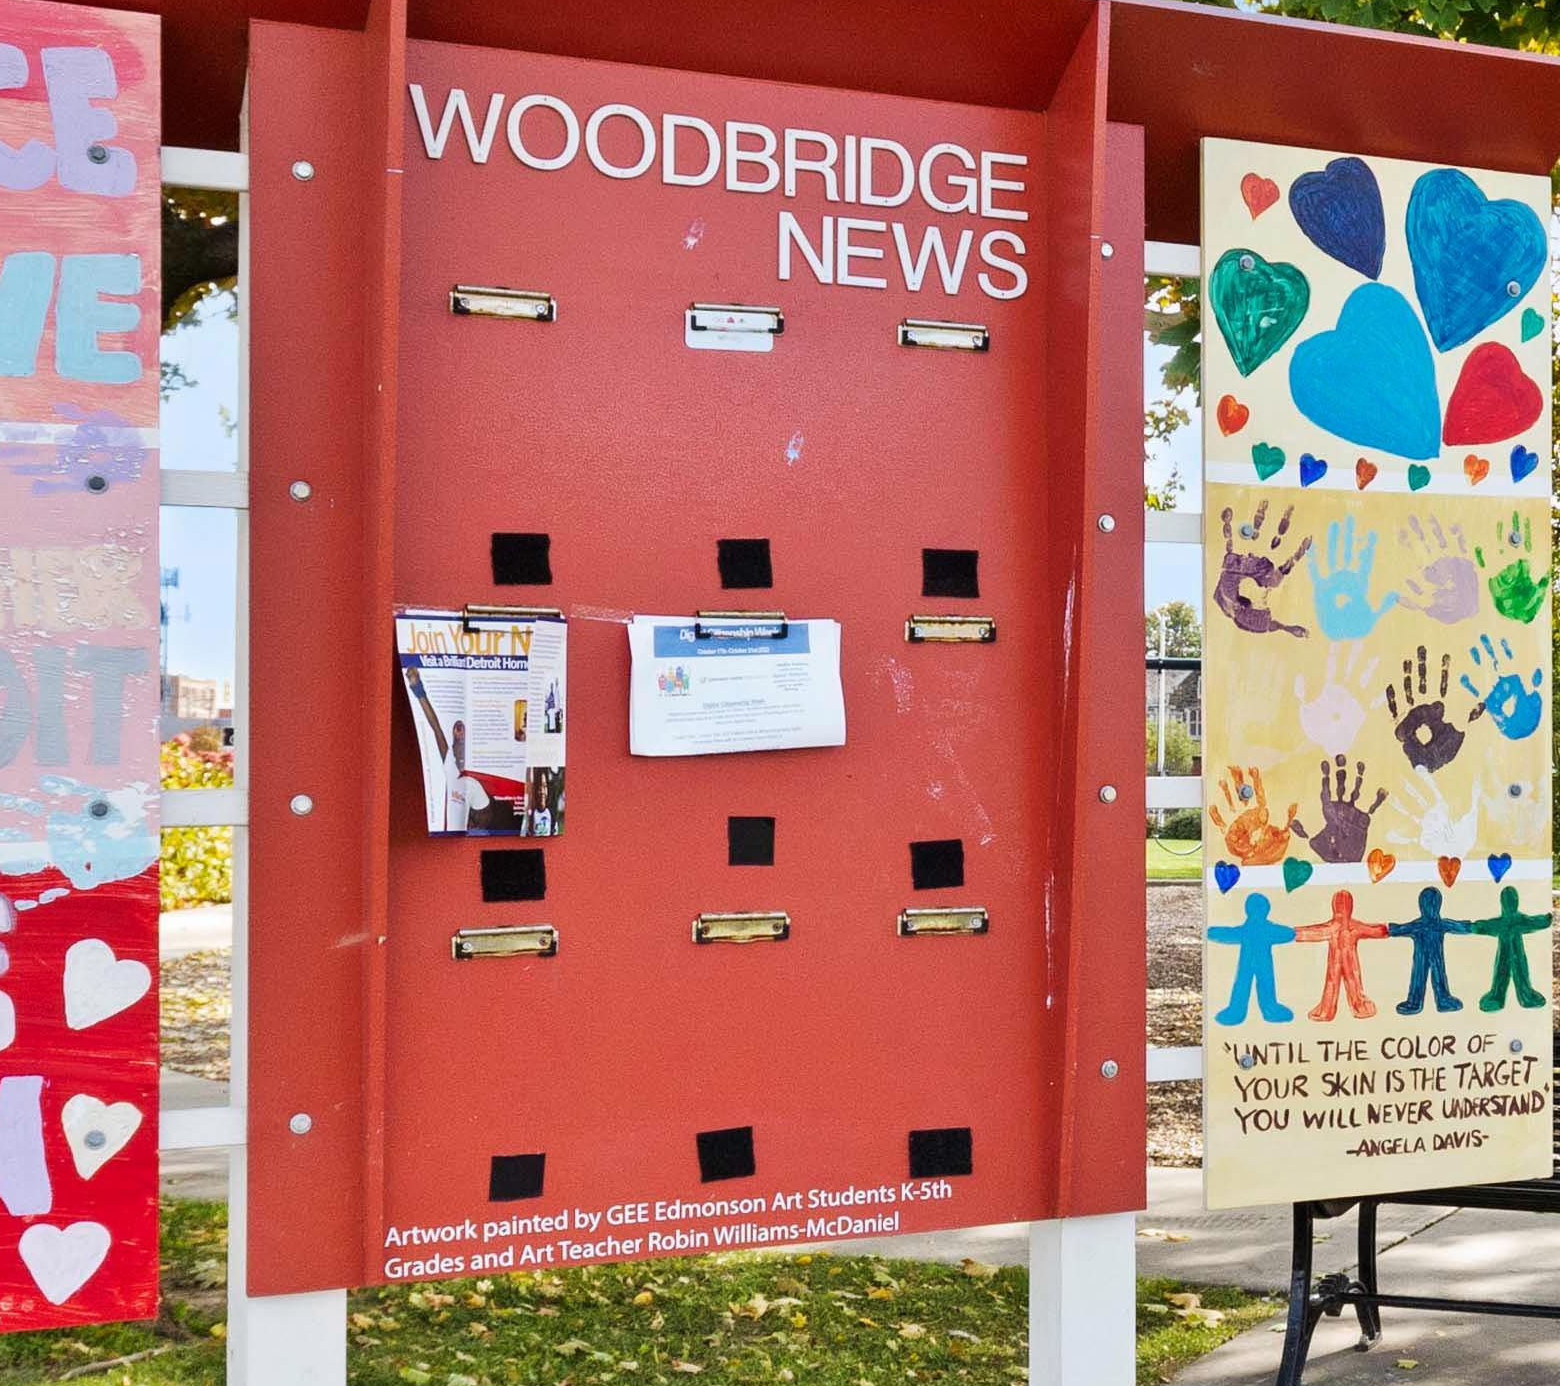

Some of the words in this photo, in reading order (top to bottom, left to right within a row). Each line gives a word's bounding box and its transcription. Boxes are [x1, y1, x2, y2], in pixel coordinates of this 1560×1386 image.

[408, 83, 1030, 221] WOODBRIDGE
[777, 210, 1030, 301] NEWS
[406, 622, 448, 655] Join
[448, 623, 504, 656] Your
[466, 656, 502, 669] Detroit
[1317, 1040, 1371, 1062] THE
[1380, 1034, 1456, 1060] COLOR
[1467, 1033, 1498, 1054] OF
[1234, 1074, 1310, 1103] YOUR
[1321, 1070, 1377, 1098] SKIN
[1386, 1069, 1406, 1093] IS
[1409, 1066, 1447, 1092] THE
[1453, 1055, 1539, 1089] TARGET
[1234, 1107, 1290, 1135] YOU
[1302, 1109, 1362, 1130] WILL
[1367, 1099, 1434, 1125] NEVER
[384, 1219, 478, 1248] Artwork
[483, 1210, 569, 1243] painted
[574, 1208, 601, 1232] by
[606, 1202, 649, 1225] GEE
[655, 1195, 767, 1222] Edmonson
[771, 1190, 803, 1211] Art
[807, 1184, 897, 1209] Students
[901, 1179, 953, 1202] K-5th
[384, 1252, 465, 1279] Grades
[470, 1247, 514, 1271] and
[520, 1243, 554, 1265] Art
[557, 1235, 644, 1261] Teacher
[648, 1225, 709, 1252] Robin
[713, 1211, 900, 1246] Williams-McDaniel
